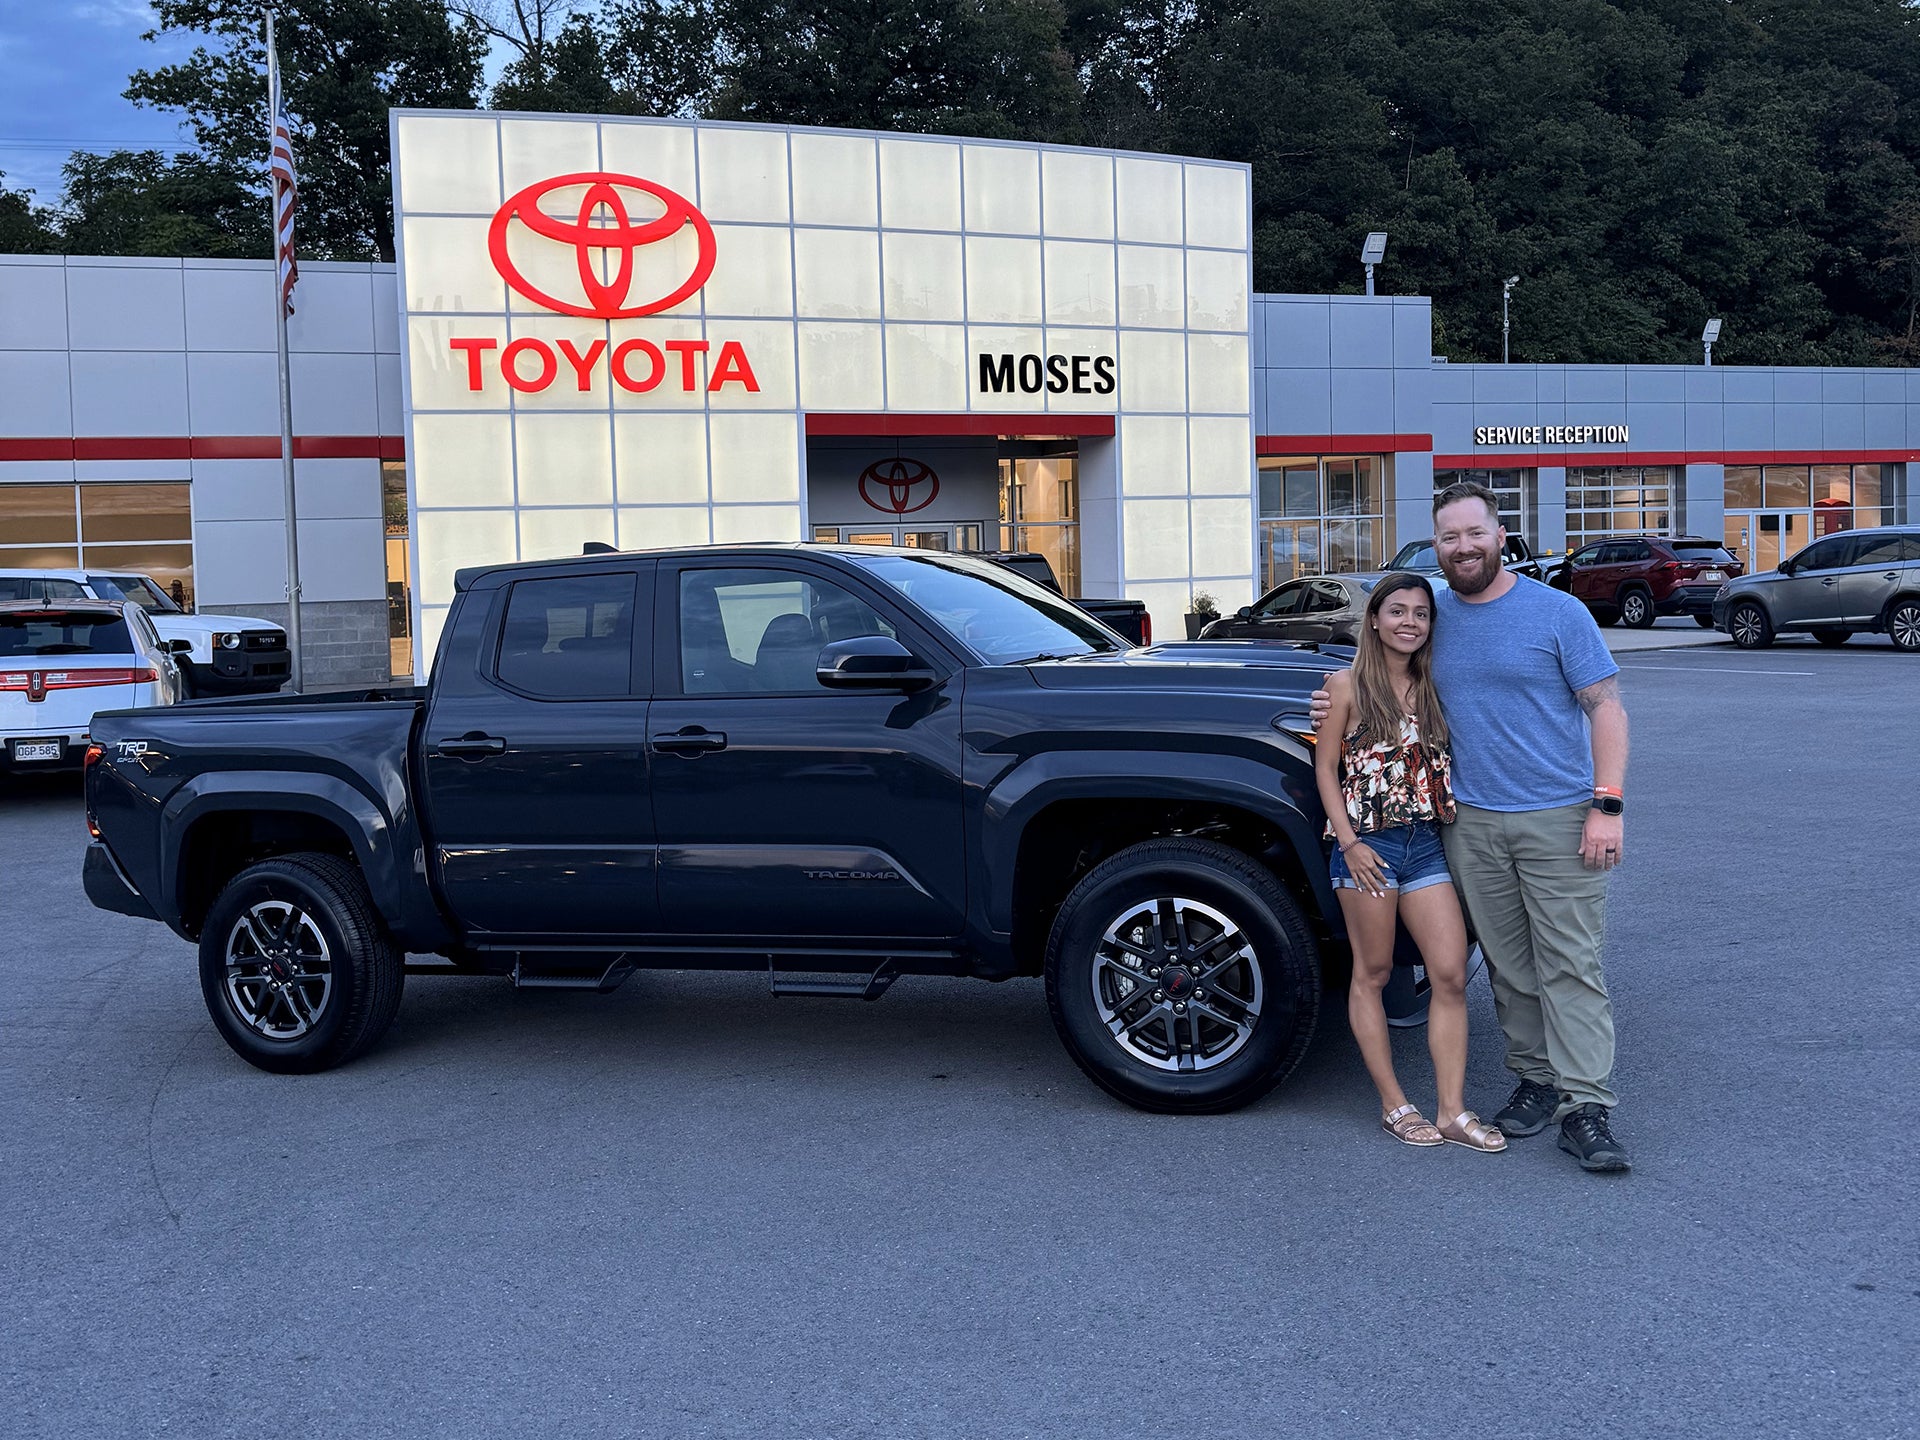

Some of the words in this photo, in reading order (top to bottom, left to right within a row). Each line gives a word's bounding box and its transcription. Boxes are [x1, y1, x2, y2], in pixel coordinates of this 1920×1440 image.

[450, 338, 761, 393] TOYOTA
[979, 354, 1116, 395] MOSES
[1475, 426, 1541, 444] SERVICE
[1544, 425, 1629, 443] RECEPTION
[38, 745, 58, 755] 585
[116, 741, 148, 756] TRD
[803, 870, 900, 880] TACOMA
